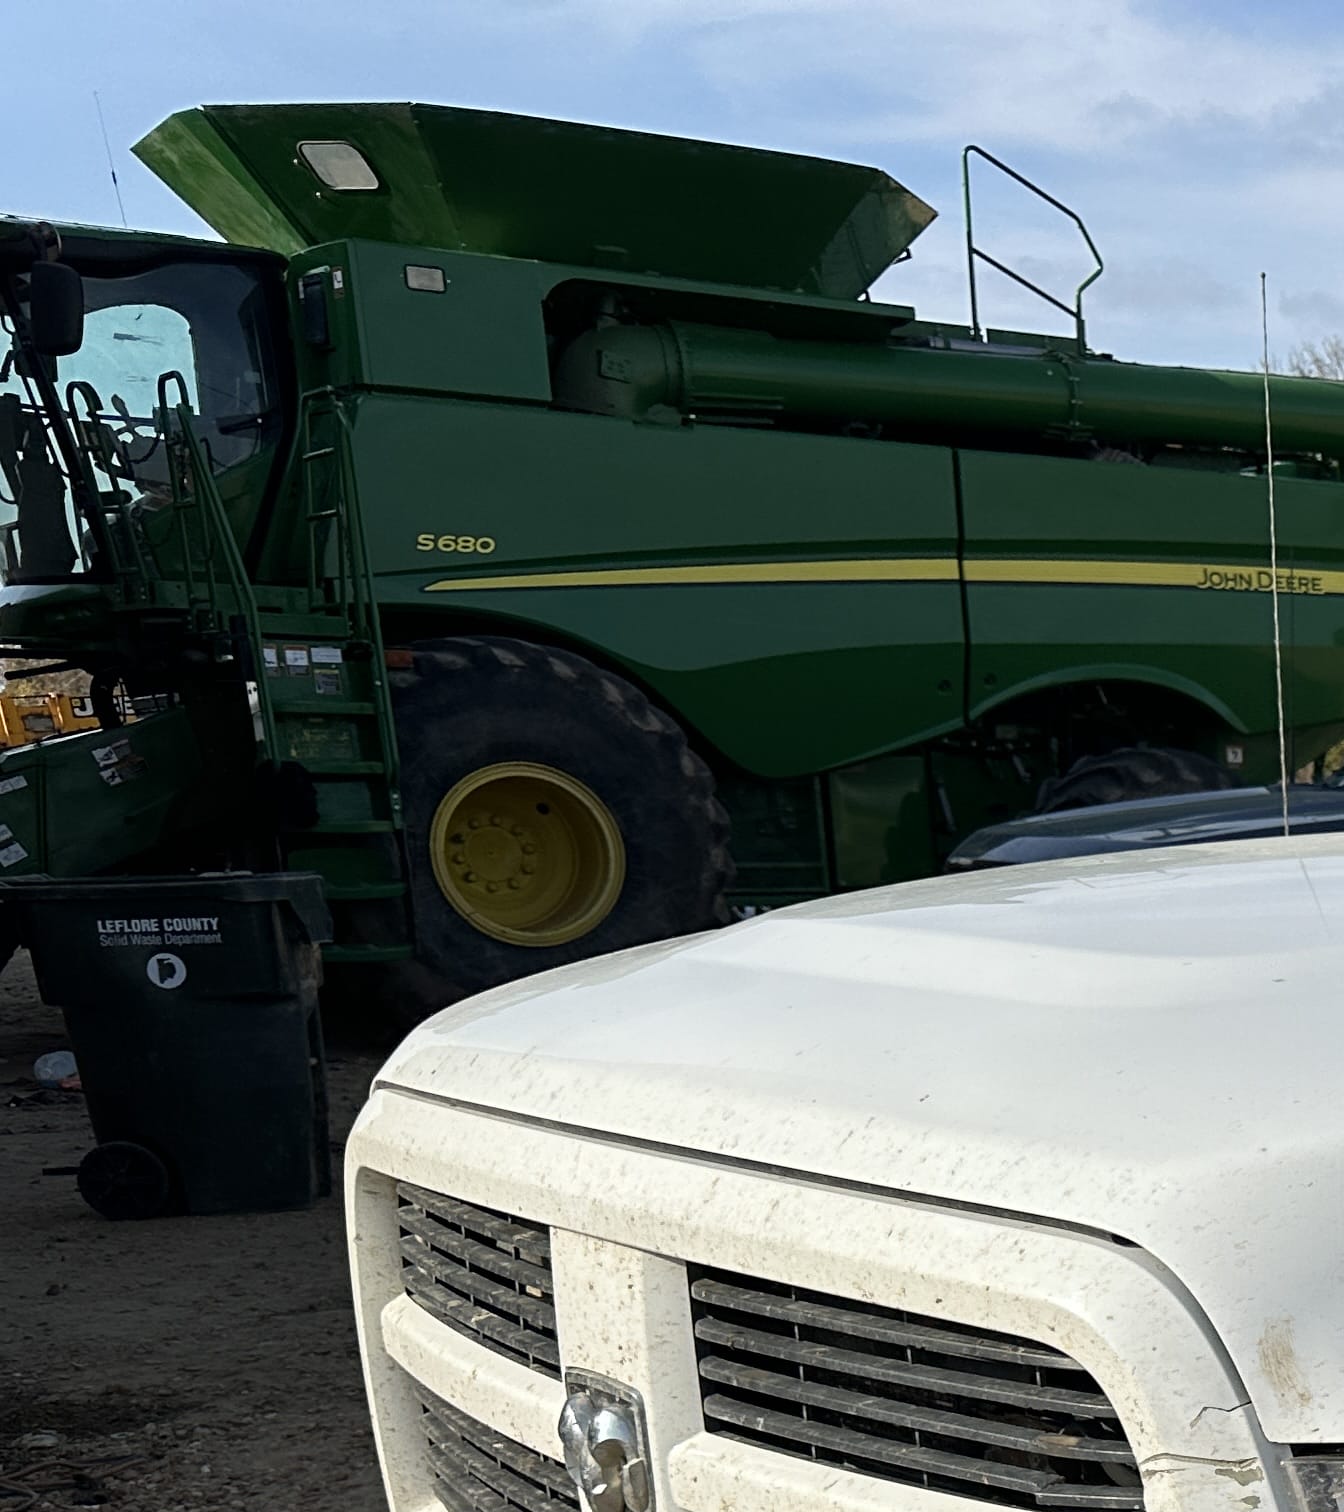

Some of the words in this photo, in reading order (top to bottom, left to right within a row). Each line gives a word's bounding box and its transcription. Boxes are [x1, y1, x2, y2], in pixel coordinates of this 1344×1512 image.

[416, 533, 496, 554] S680
[1197, 567, 1252, 587] JOHN
[1257, 570, 1323, 592] DEERE
[97, 918, 160, 933] LEFLORE
[163, 916, 219, 931] COUNTY
[99, 933, 128, 947] Solid
[130, 933, 162, 946] Waste
[164, 932, 222, 946] Department
